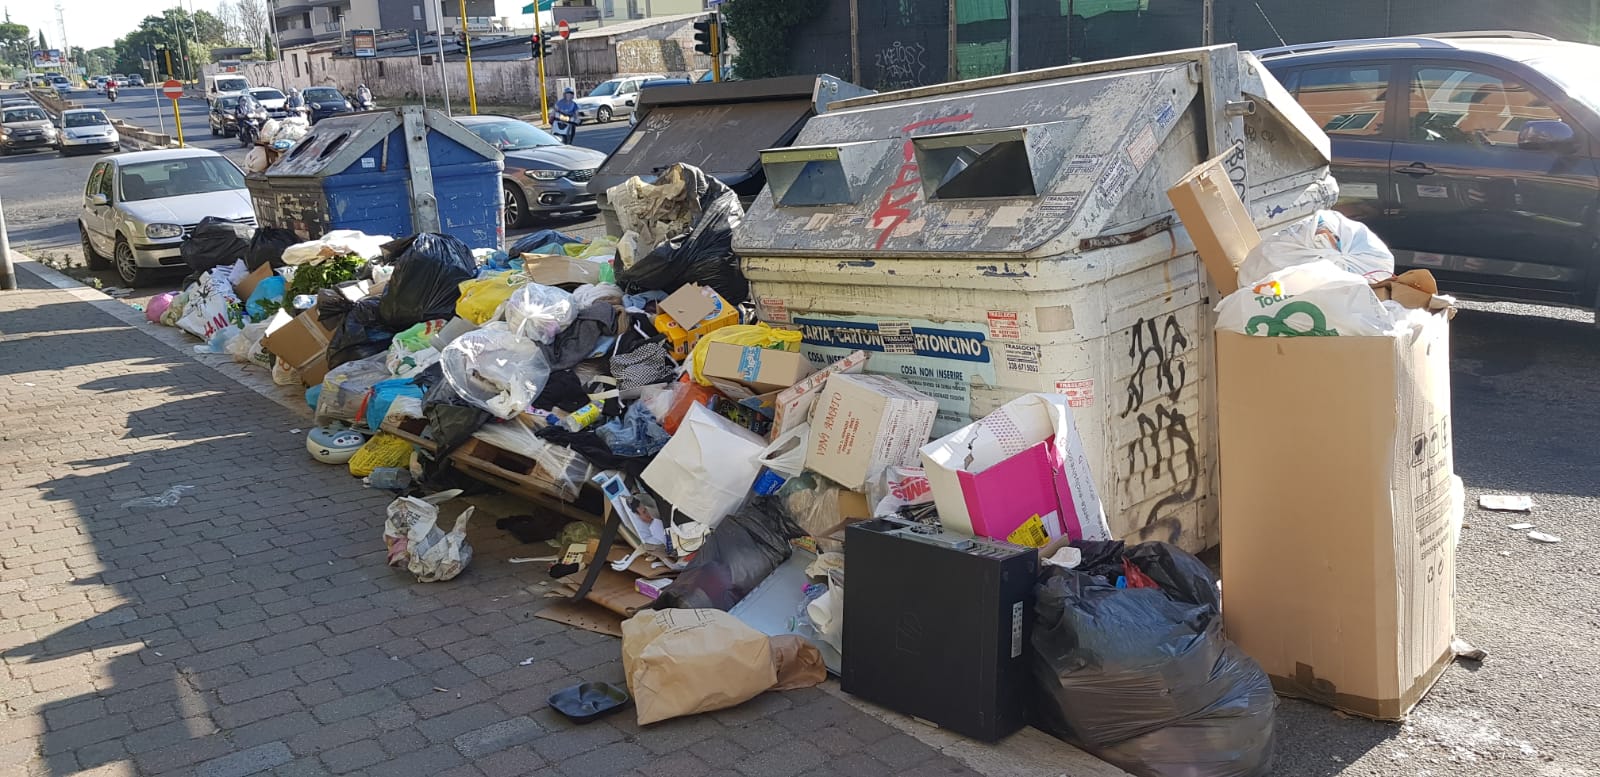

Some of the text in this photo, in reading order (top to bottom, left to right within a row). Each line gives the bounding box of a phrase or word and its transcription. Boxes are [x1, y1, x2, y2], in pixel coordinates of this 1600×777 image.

[801, 324, 835, 345] CARTA,
[913, 333, 982, 357] RTONCINO
[1005, 343, 1037, 351] TRASLOCHI
[807, 351, 825, 363] COSA
[901, 365, 964, 381] COSA NON INSERIRE
[825, 391, 842, 431] AMATO
